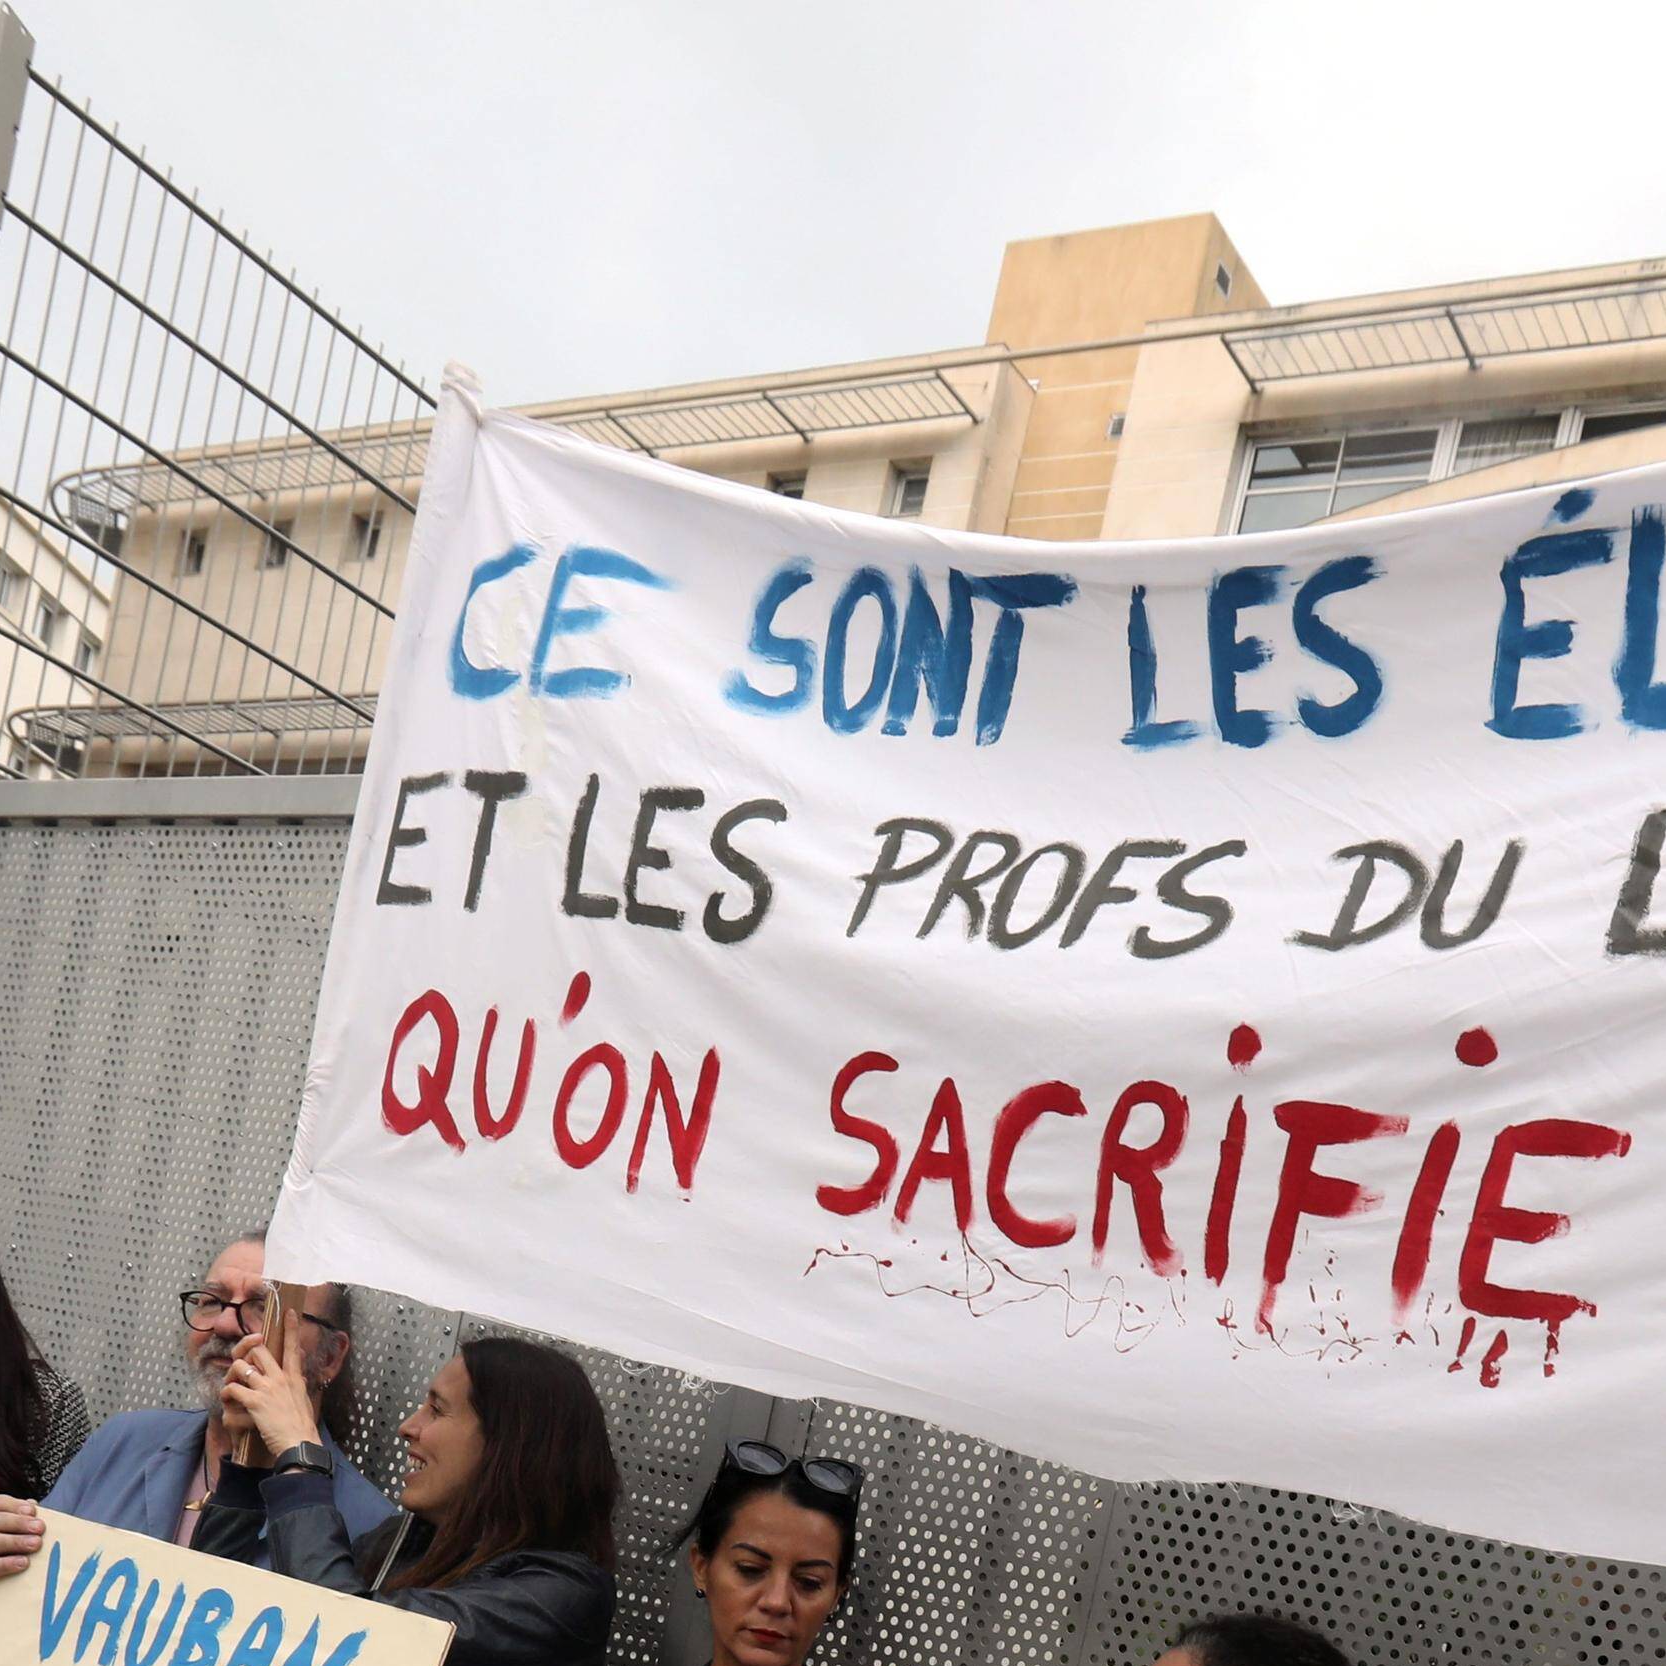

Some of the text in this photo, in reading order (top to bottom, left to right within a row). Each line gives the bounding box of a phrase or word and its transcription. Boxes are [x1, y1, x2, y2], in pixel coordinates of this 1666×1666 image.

[449, 540, 679, 701] CE
[723, 562, 1077, 747] SONT
[1121, 553, 1385, 752] LES
[376, 769, 529, 913] ET
[561, 773, 787, 946] LES
[846, 816, 1248, 961] PROFS
[1283, 838, 1525, 952] DU
[382, 970, 723, 1201] QU'ON
